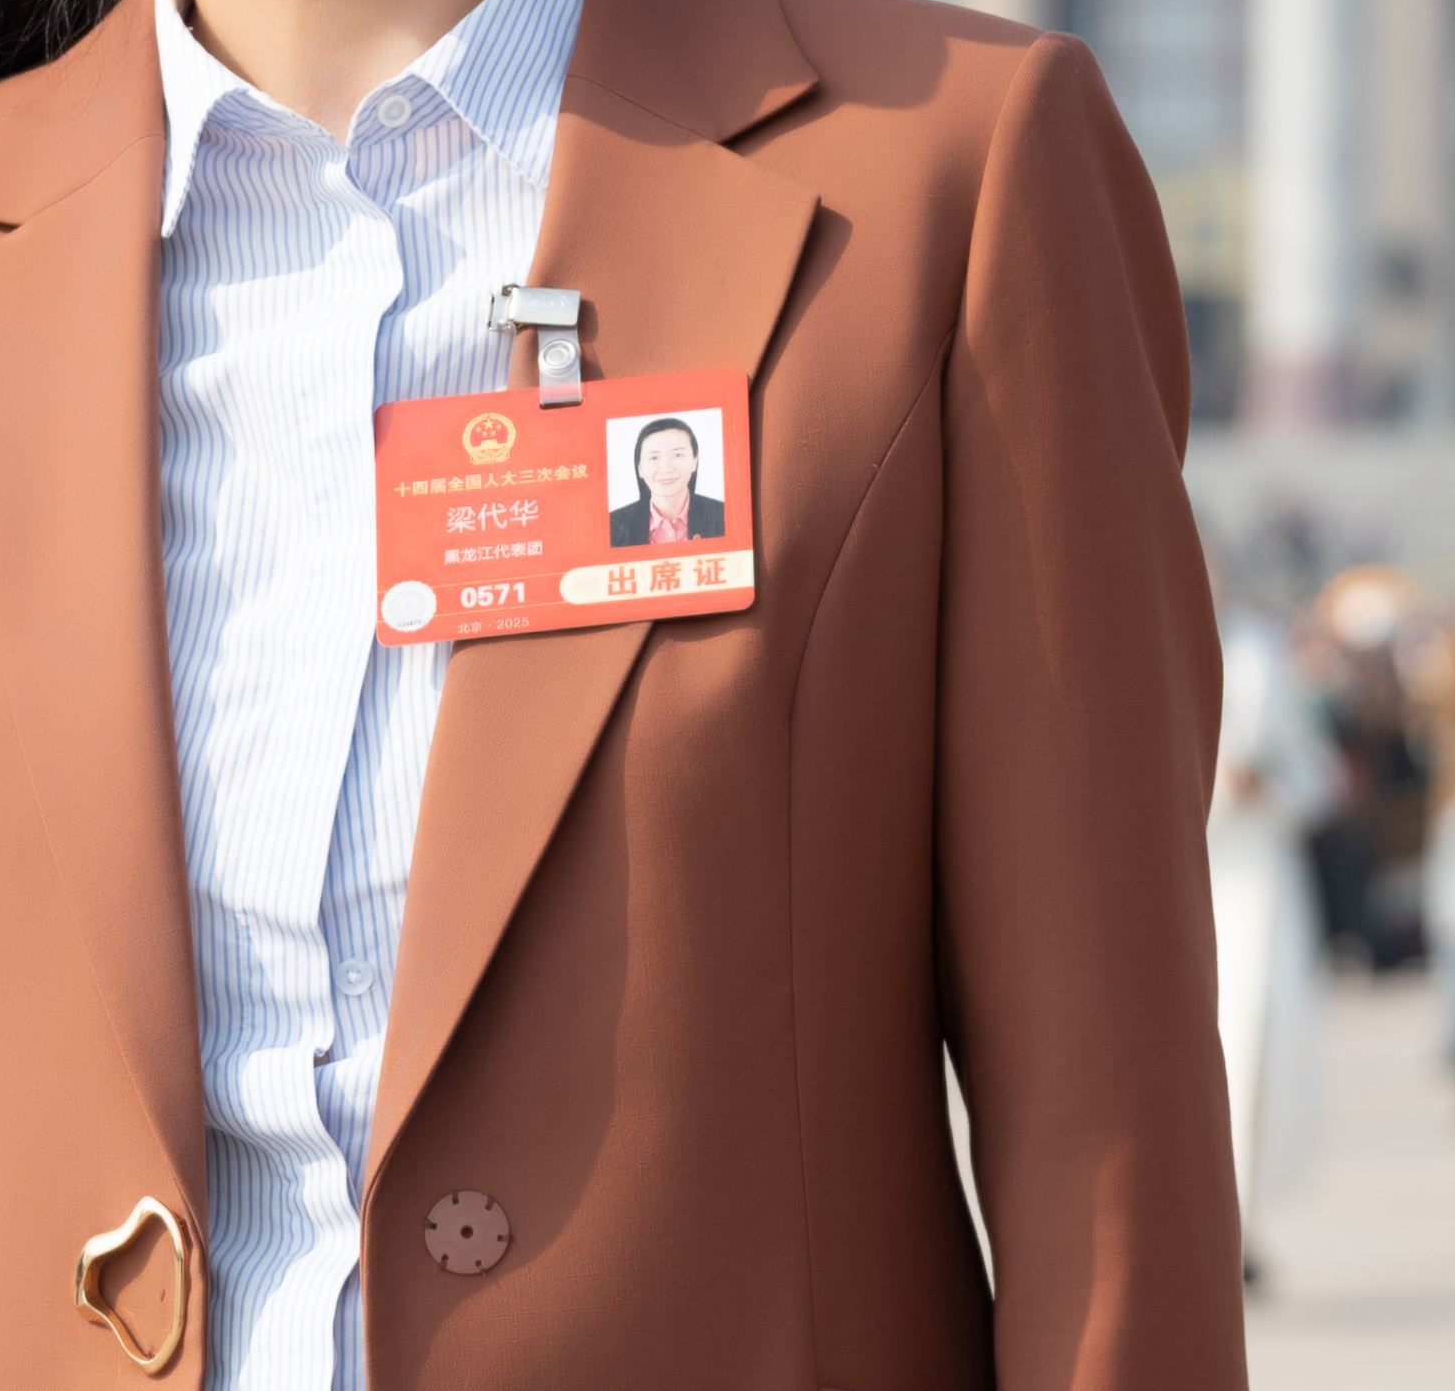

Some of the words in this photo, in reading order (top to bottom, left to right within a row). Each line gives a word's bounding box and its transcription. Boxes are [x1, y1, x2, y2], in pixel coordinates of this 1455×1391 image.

[394, 464, 588, 497] 十四届全国人大三次会议
[446, 499, 539, 533] 梁代华
[444, 540, 543, 564] 黑龙江代表团
[608, 558, 727, 596] 出席证
[460, 582, 526, 609] 0571
